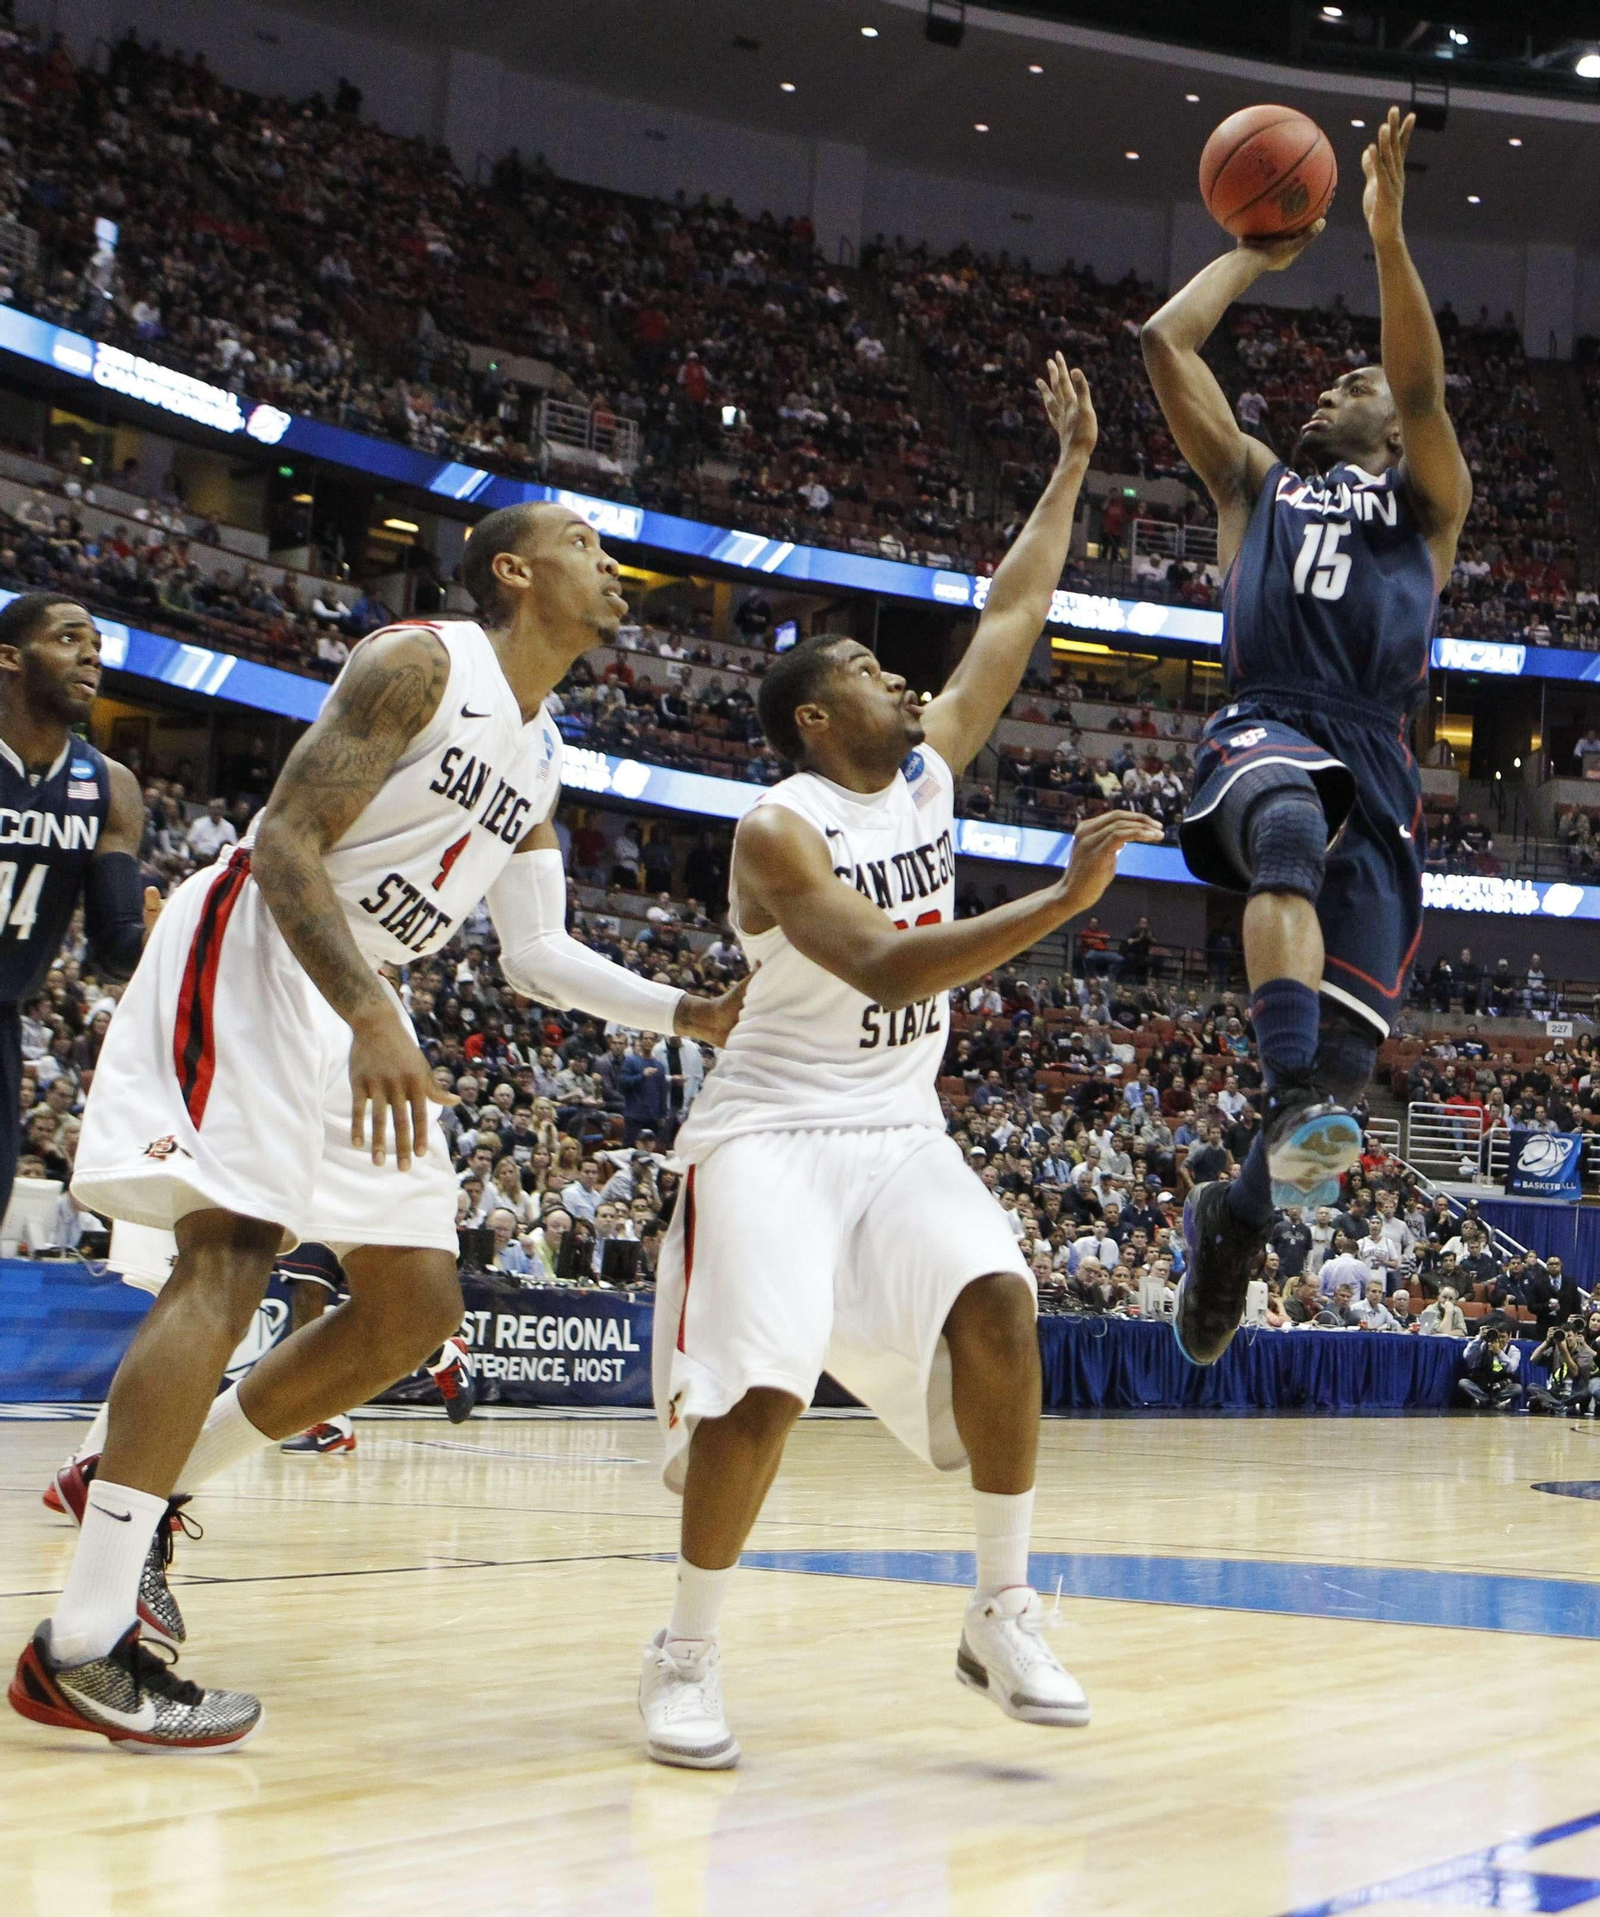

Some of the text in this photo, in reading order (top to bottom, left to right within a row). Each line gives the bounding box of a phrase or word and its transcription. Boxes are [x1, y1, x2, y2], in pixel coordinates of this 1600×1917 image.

[1293, 520, 1352, 601] 15
[1440, 642, 1520, 675] NCAA
[430, 747, 492, 811] SAN
[0, 807, 98, 850] CONN
[960, 829, 1017, 857] NCAA
[432, 831, 472, 891] 1
[359, 872, 453, 953] STATE
[859, 994, 941, 1049] STATE
[1551, 1024, 1568, 1034] 227
[1522, 1180, 1577, 1191] BASKETBALL
[460, 1310, 641, 1353] ST REGIONAL
[574, 1357, 625, 1383] HOST
